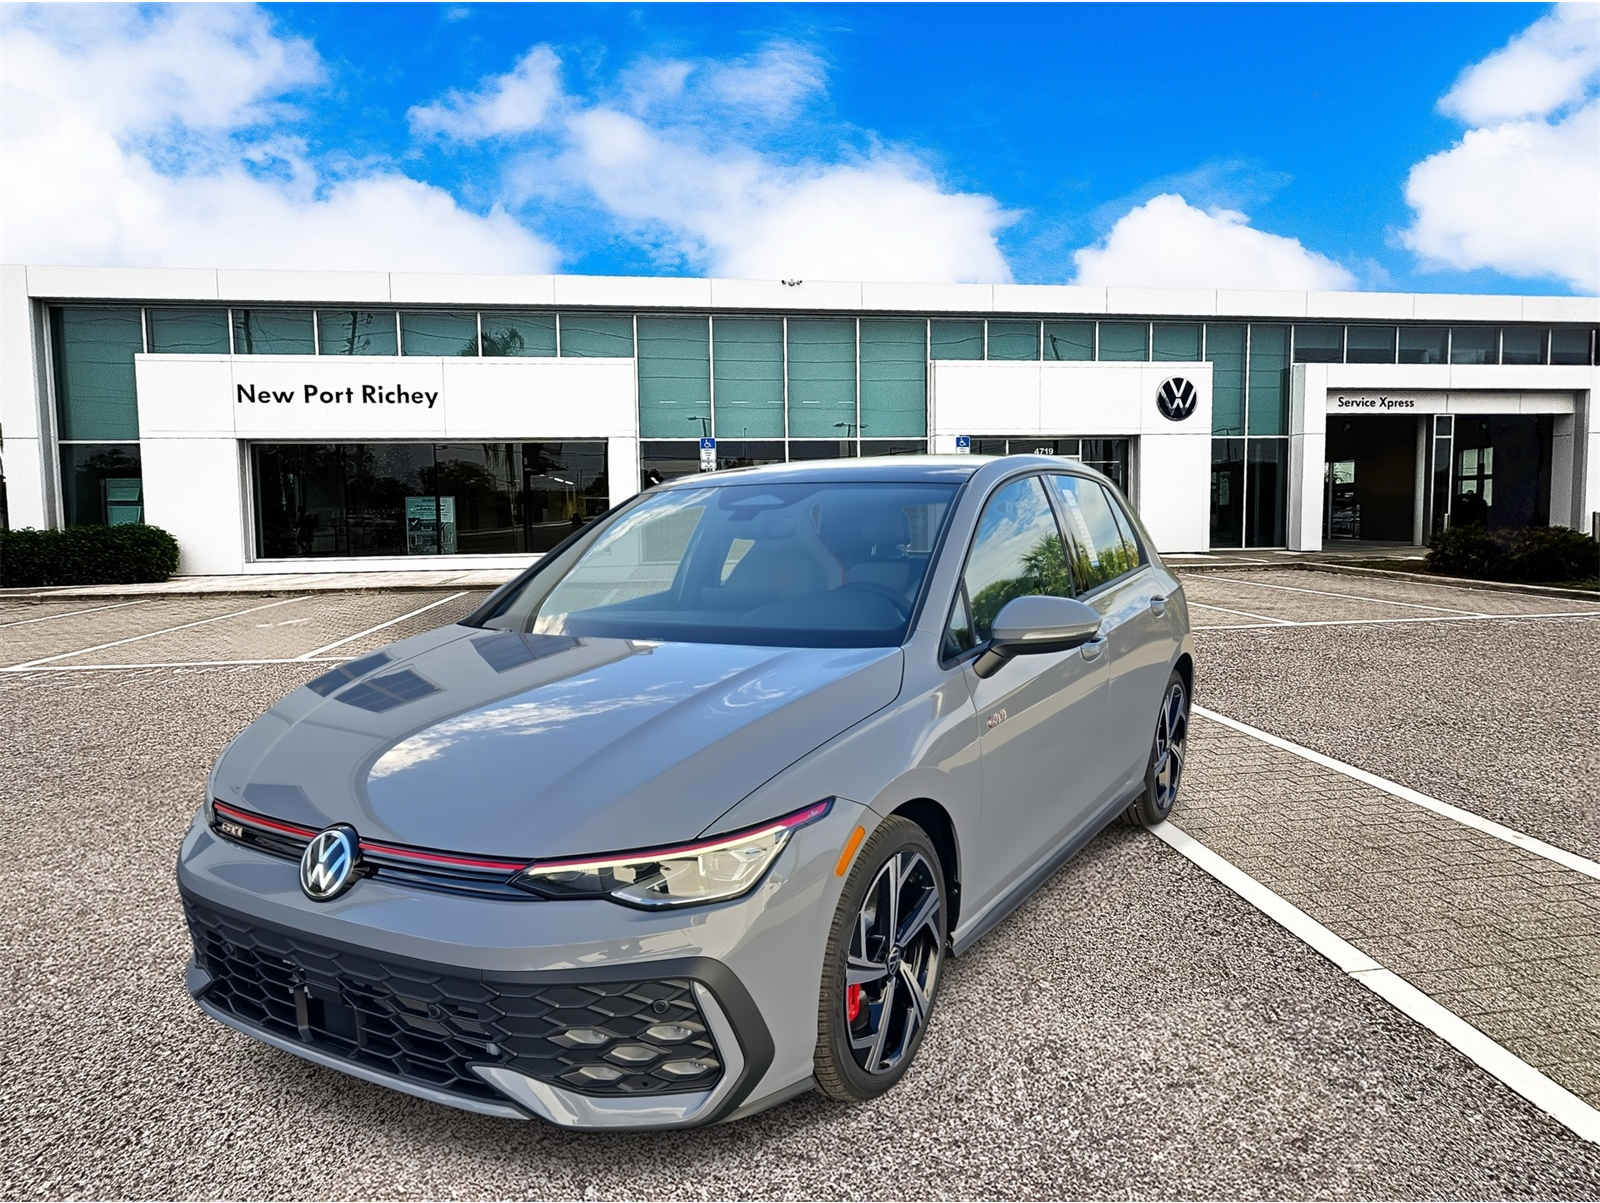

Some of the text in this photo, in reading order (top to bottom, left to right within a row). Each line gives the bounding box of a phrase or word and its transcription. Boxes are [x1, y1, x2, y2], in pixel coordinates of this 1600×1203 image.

[236, 384, 438, 408] New Port Richey
[1156, 376, 1198, 421] VW
[1337, 396, 1415, 410] Service Xpress
[1033, 447, 1054, 456] 4719
[300, 829, 352, 898] VW
